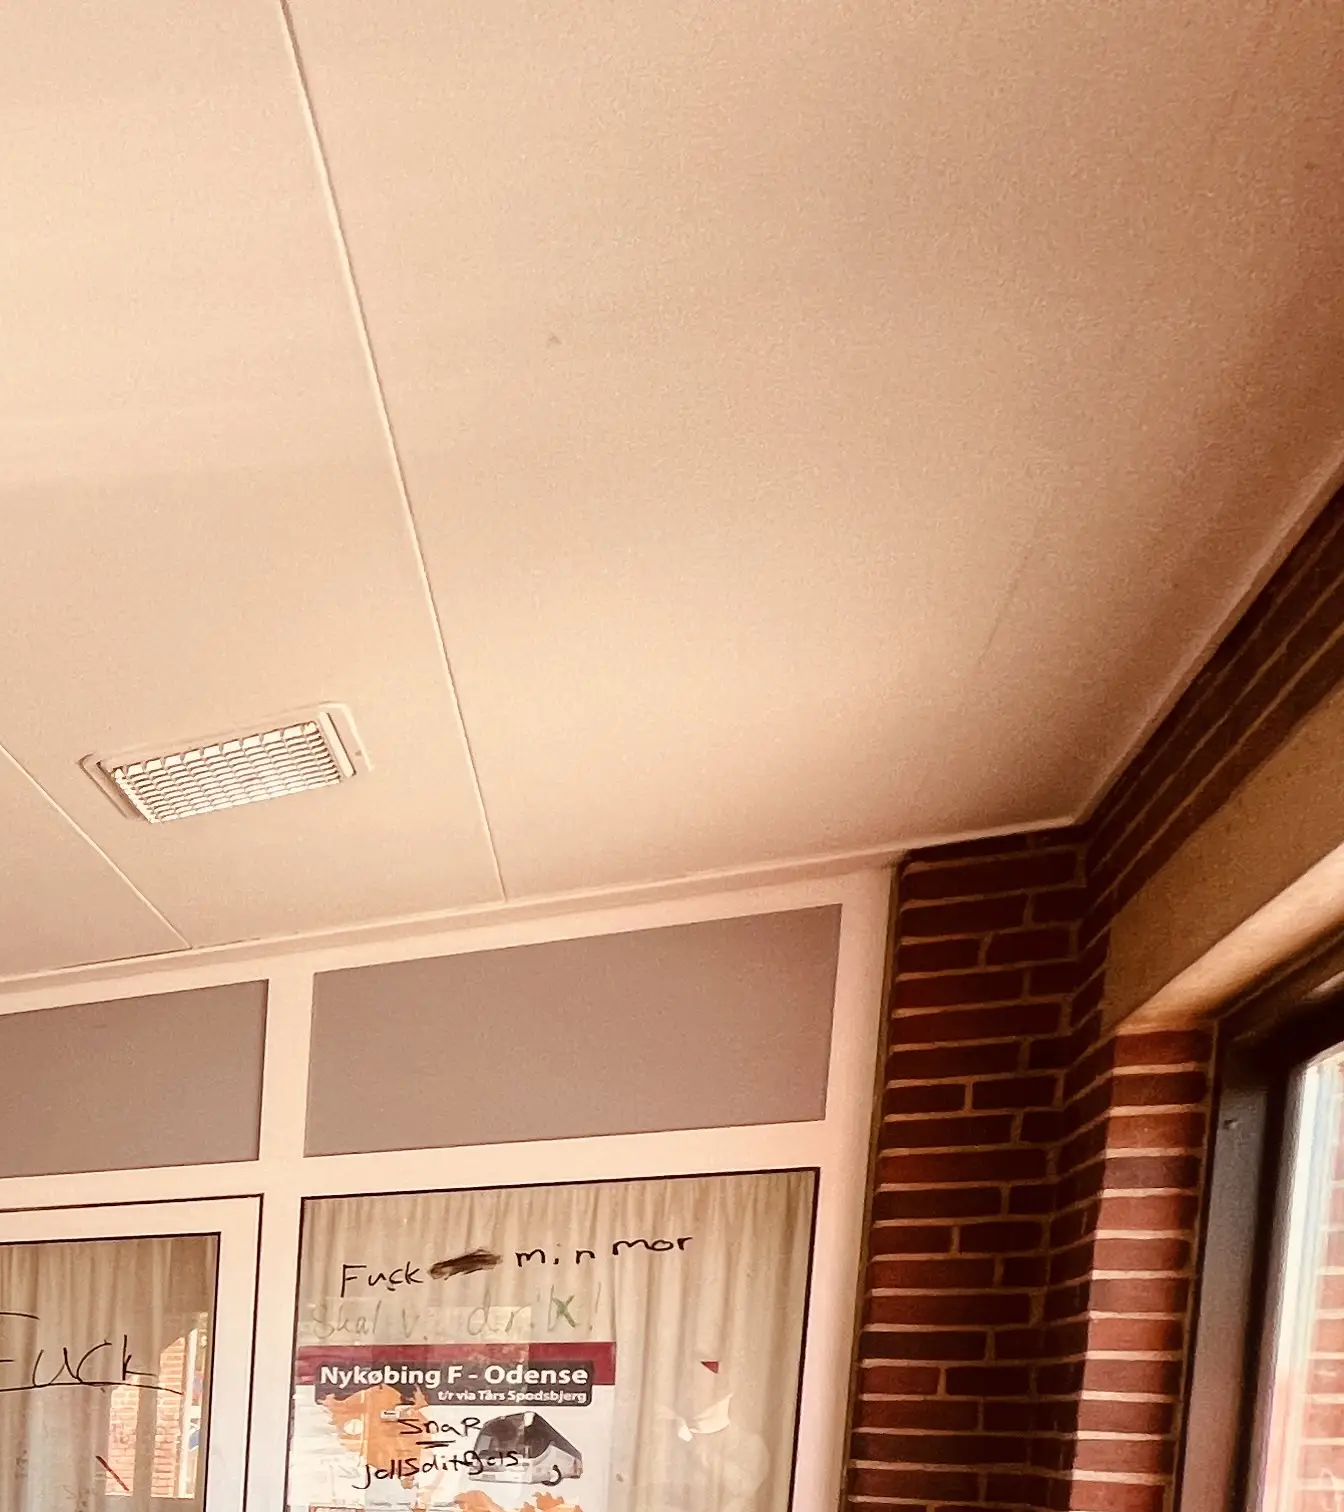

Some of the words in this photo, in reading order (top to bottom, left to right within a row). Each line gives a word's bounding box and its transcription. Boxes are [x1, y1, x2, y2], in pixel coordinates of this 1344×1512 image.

[612, 1237, 693, 1255] mor
[320, 1365, 441, 1388] Nykøbing
[448, 1365, 463, 1384] F
[485, 1365, 588, 1385] Odense
[456, 1391, 476, 1401] via
[478, 1389, 506, 1401] Tårs
[508, 1391, 587, 1404] Spodsbjerg
